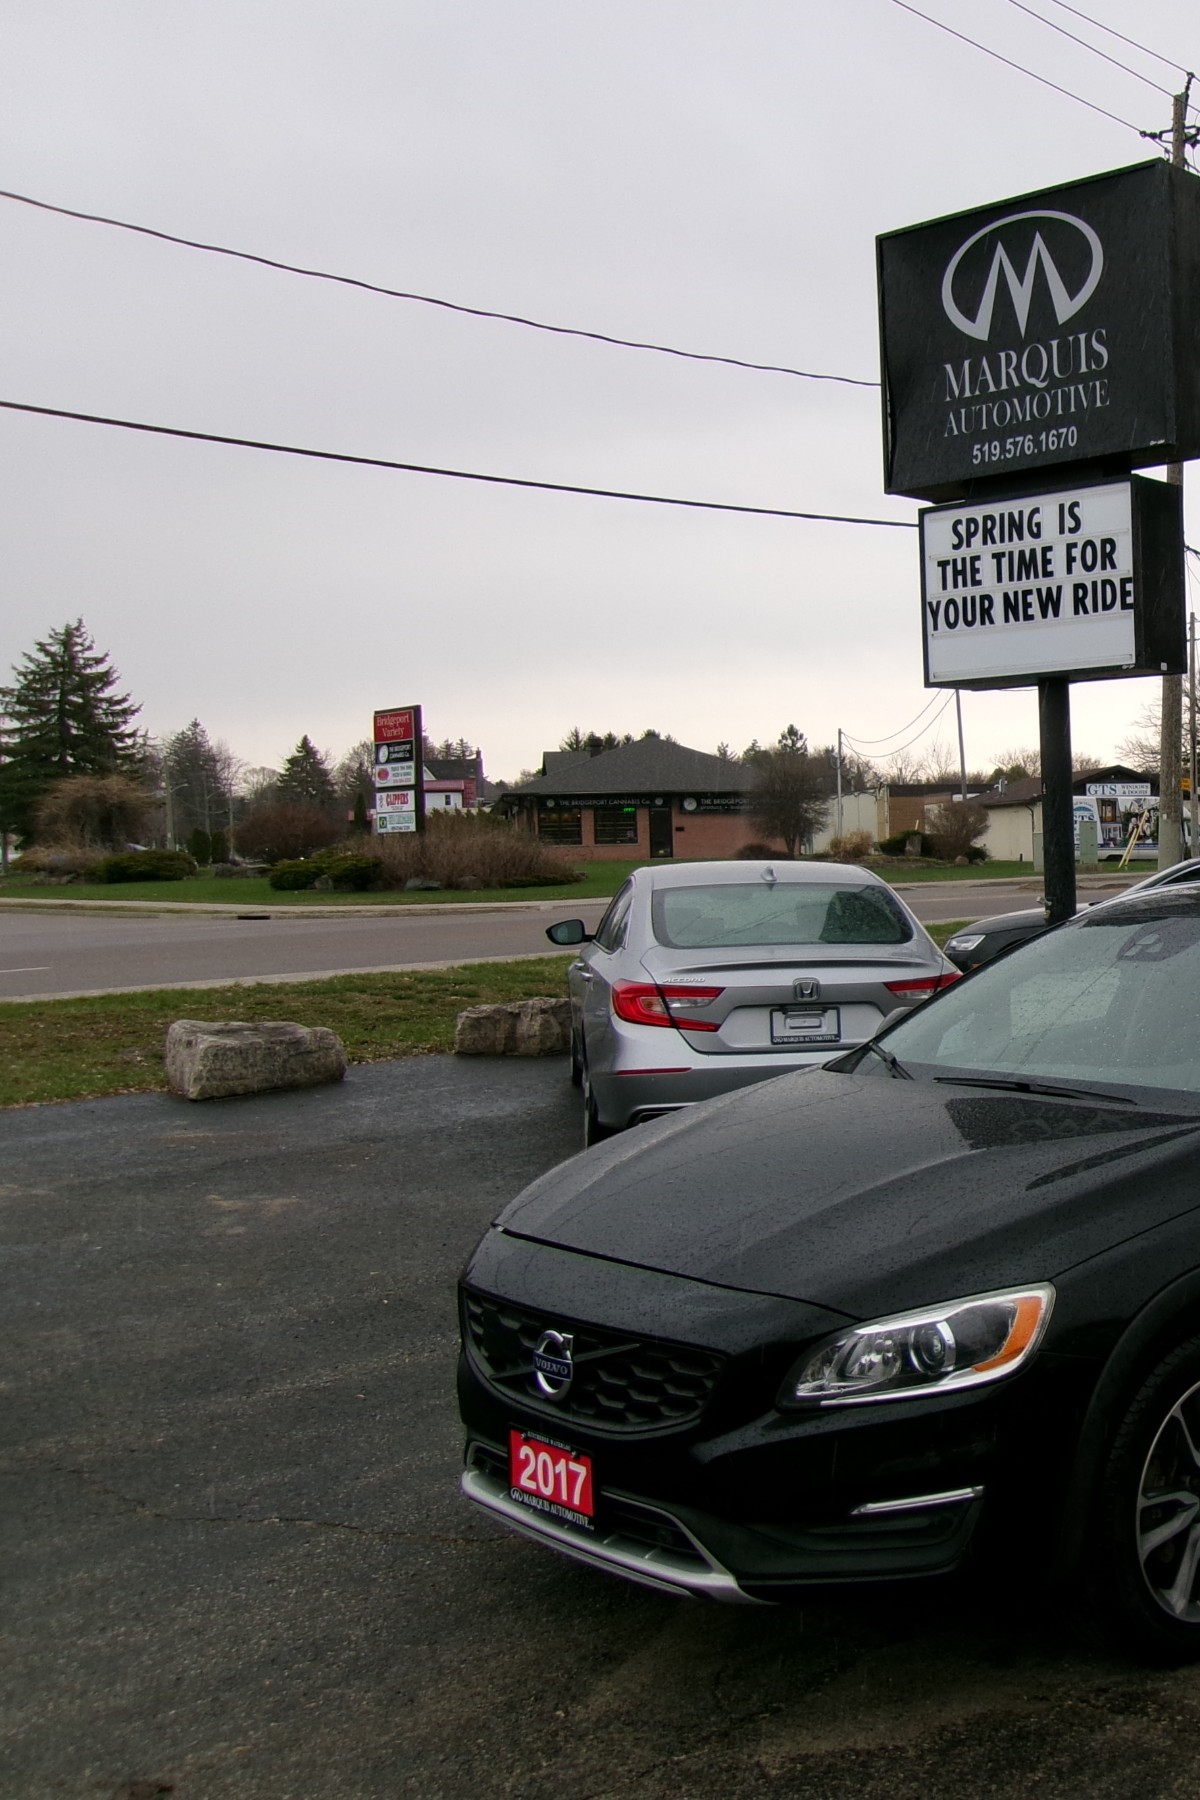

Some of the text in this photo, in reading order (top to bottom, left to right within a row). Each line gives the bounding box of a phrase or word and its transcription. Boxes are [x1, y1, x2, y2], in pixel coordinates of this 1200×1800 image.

[944, 328, 1109, 402] MARQUIS
[944, 379, 1110, 437] AUTOMOTIVE
[972, 426, 1078, 464] 519.576.1670
[952, 501, 1082, 551] SPRING IS
[937, 538, 1117, 591] THE TIME FOR
[928, 577, 1134, 632] YOUR NEW RIDE
[376, 713, 409, 727] Bridgeport
[382, 727, 404, 738] Variety
[1087, 784, 1117, 795] GTS
[535, 1358, 568, 1375] VOLVO
[520, 1445, 587, 1506] 2017
[522, 1492, 550, 1511] MARQUIS
